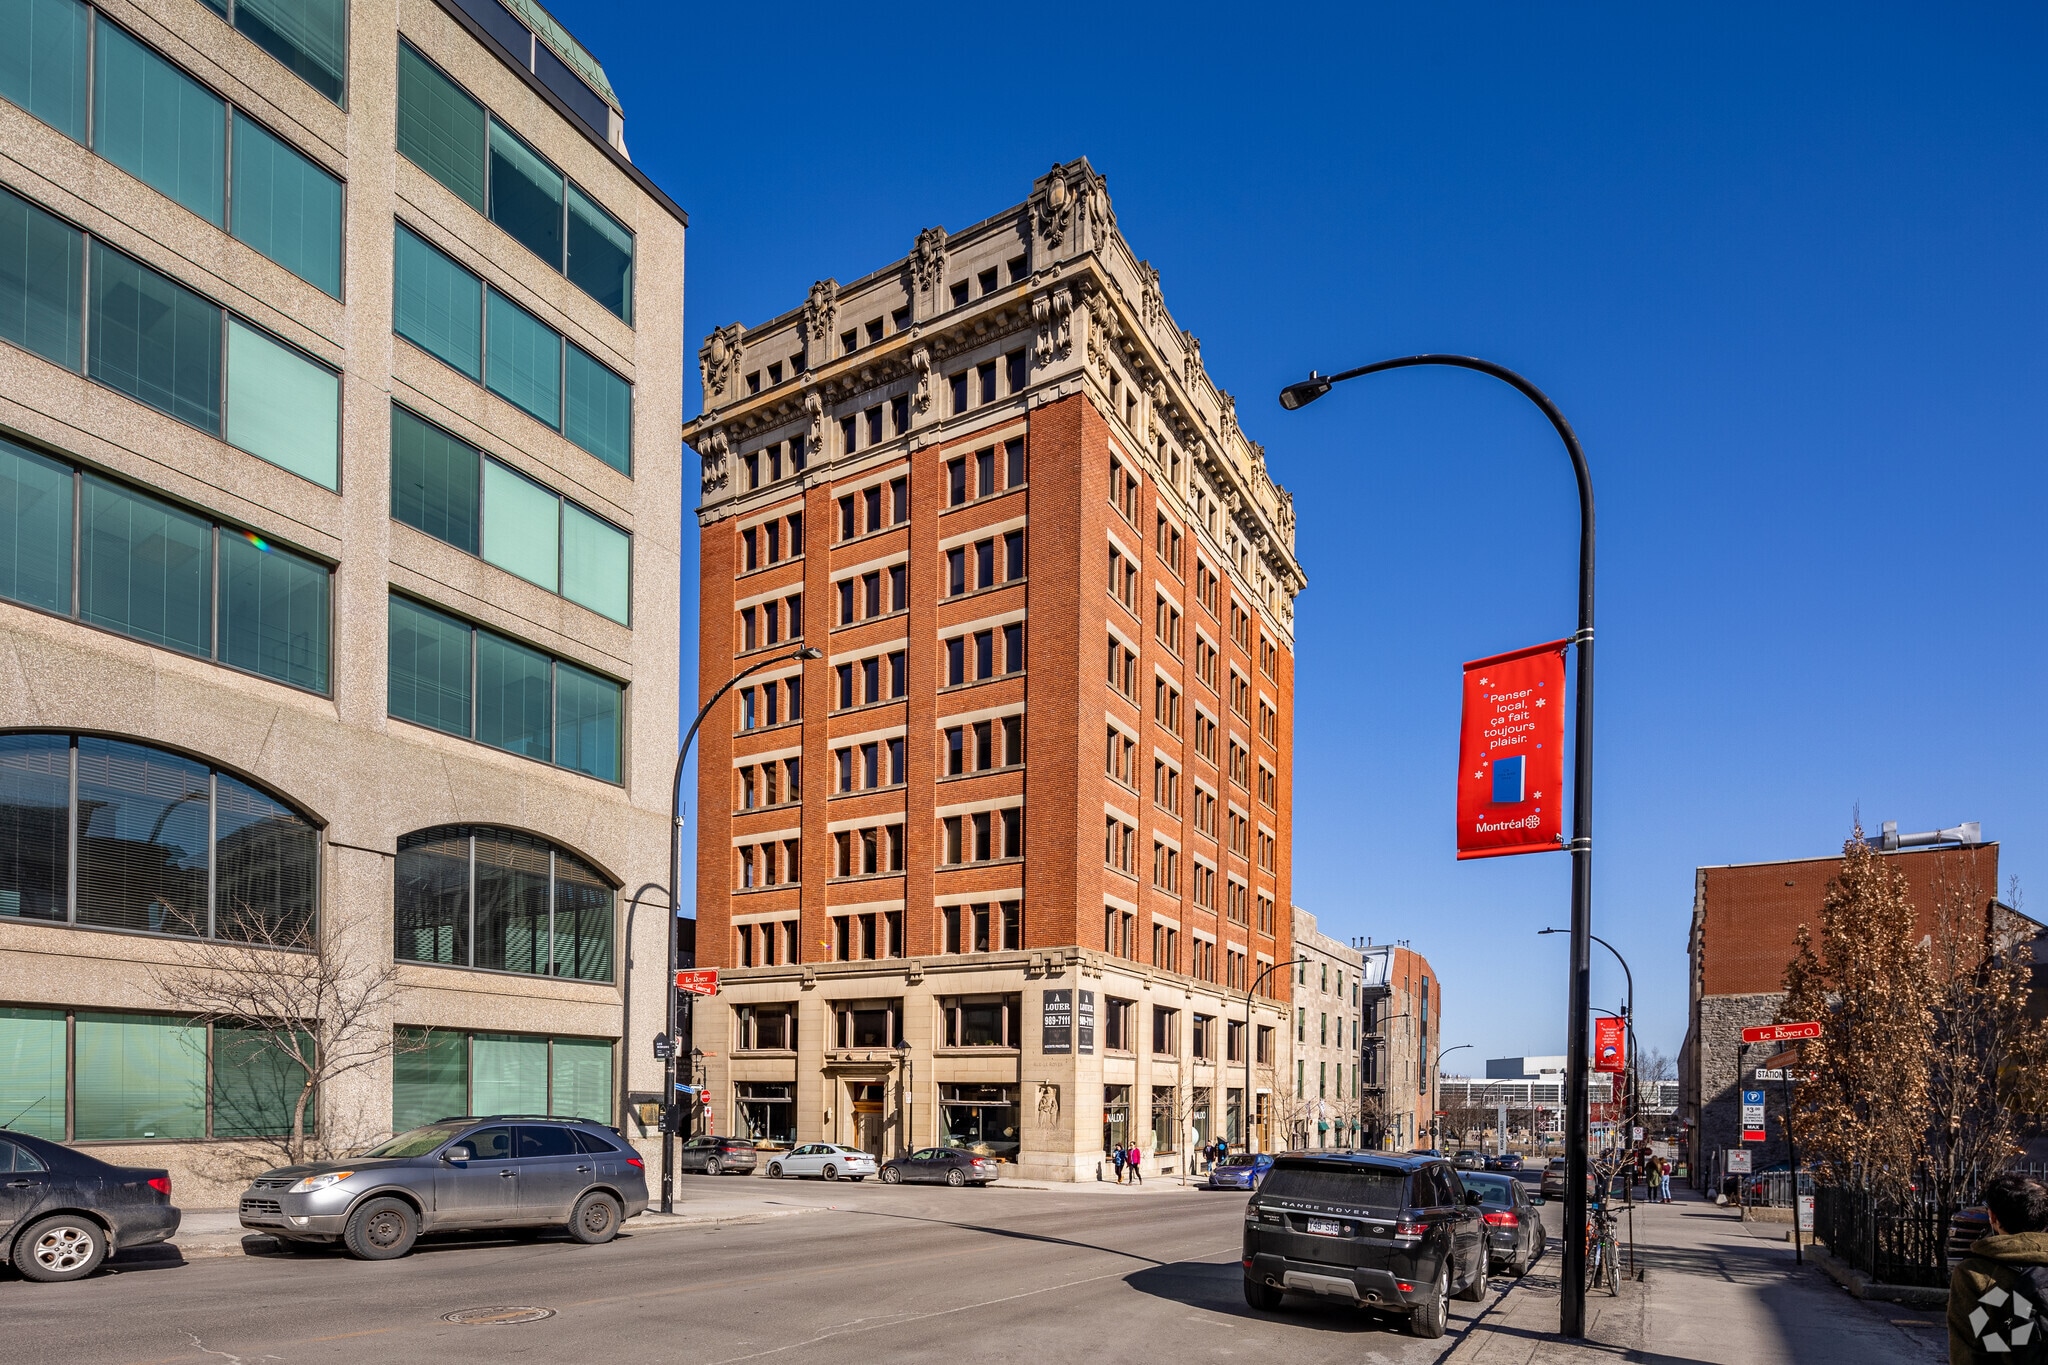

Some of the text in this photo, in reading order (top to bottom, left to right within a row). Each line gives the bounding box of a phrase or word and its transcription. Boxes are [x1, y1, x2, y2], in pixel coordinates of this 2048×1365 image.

[1490, 689, 1532, 703] Penser
[1496, 700, 1528, 713] local,
[1490, 711, 1530, 727] ça fait
[1484, 722, 1535, 738] toujours
[1490, 734, 1528, 750] plaisir.
[1476, 818, 1524, 833] Montréal
[1045, 1003, 1070, 1011] LOUER
[1775, 1030, 1803, 1039] Royer
[1804, 1028, 1815, 1036] O.
[1281, 1201, 1370, 1216] RANGE ROVER
